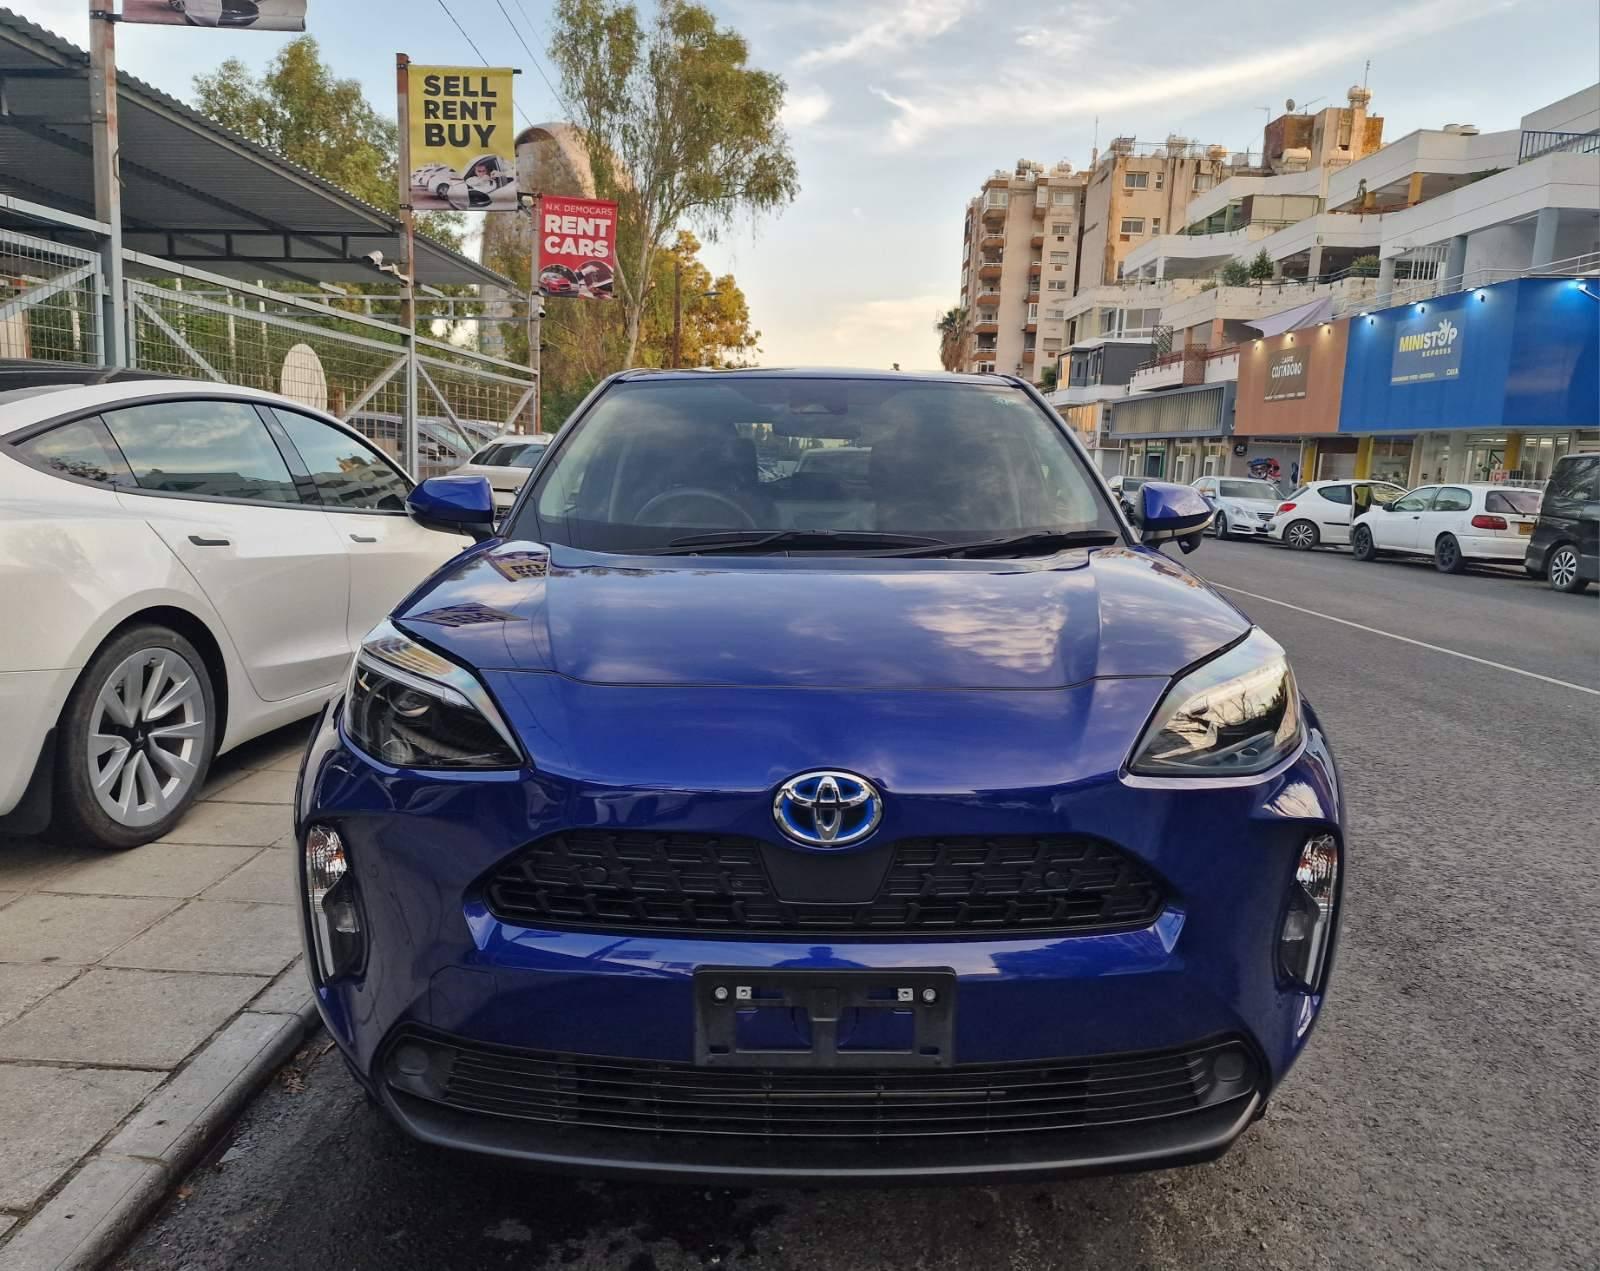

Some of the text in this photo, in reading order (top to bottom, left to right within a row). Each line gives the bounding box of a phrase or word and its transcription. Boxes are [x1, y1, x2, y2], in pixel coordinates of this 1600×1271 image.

[423, 74, 497, 98] SELL
[423, 99, 497, 121] RENT
[424, 123, 497, 148] BUY
[564, 204, 613, 216] DEMOCARS
[544, 213, 612, 238] RENT
[544, 235, 609, 258] CARS
[1399, 318, 1458, 353] MINISTOP
